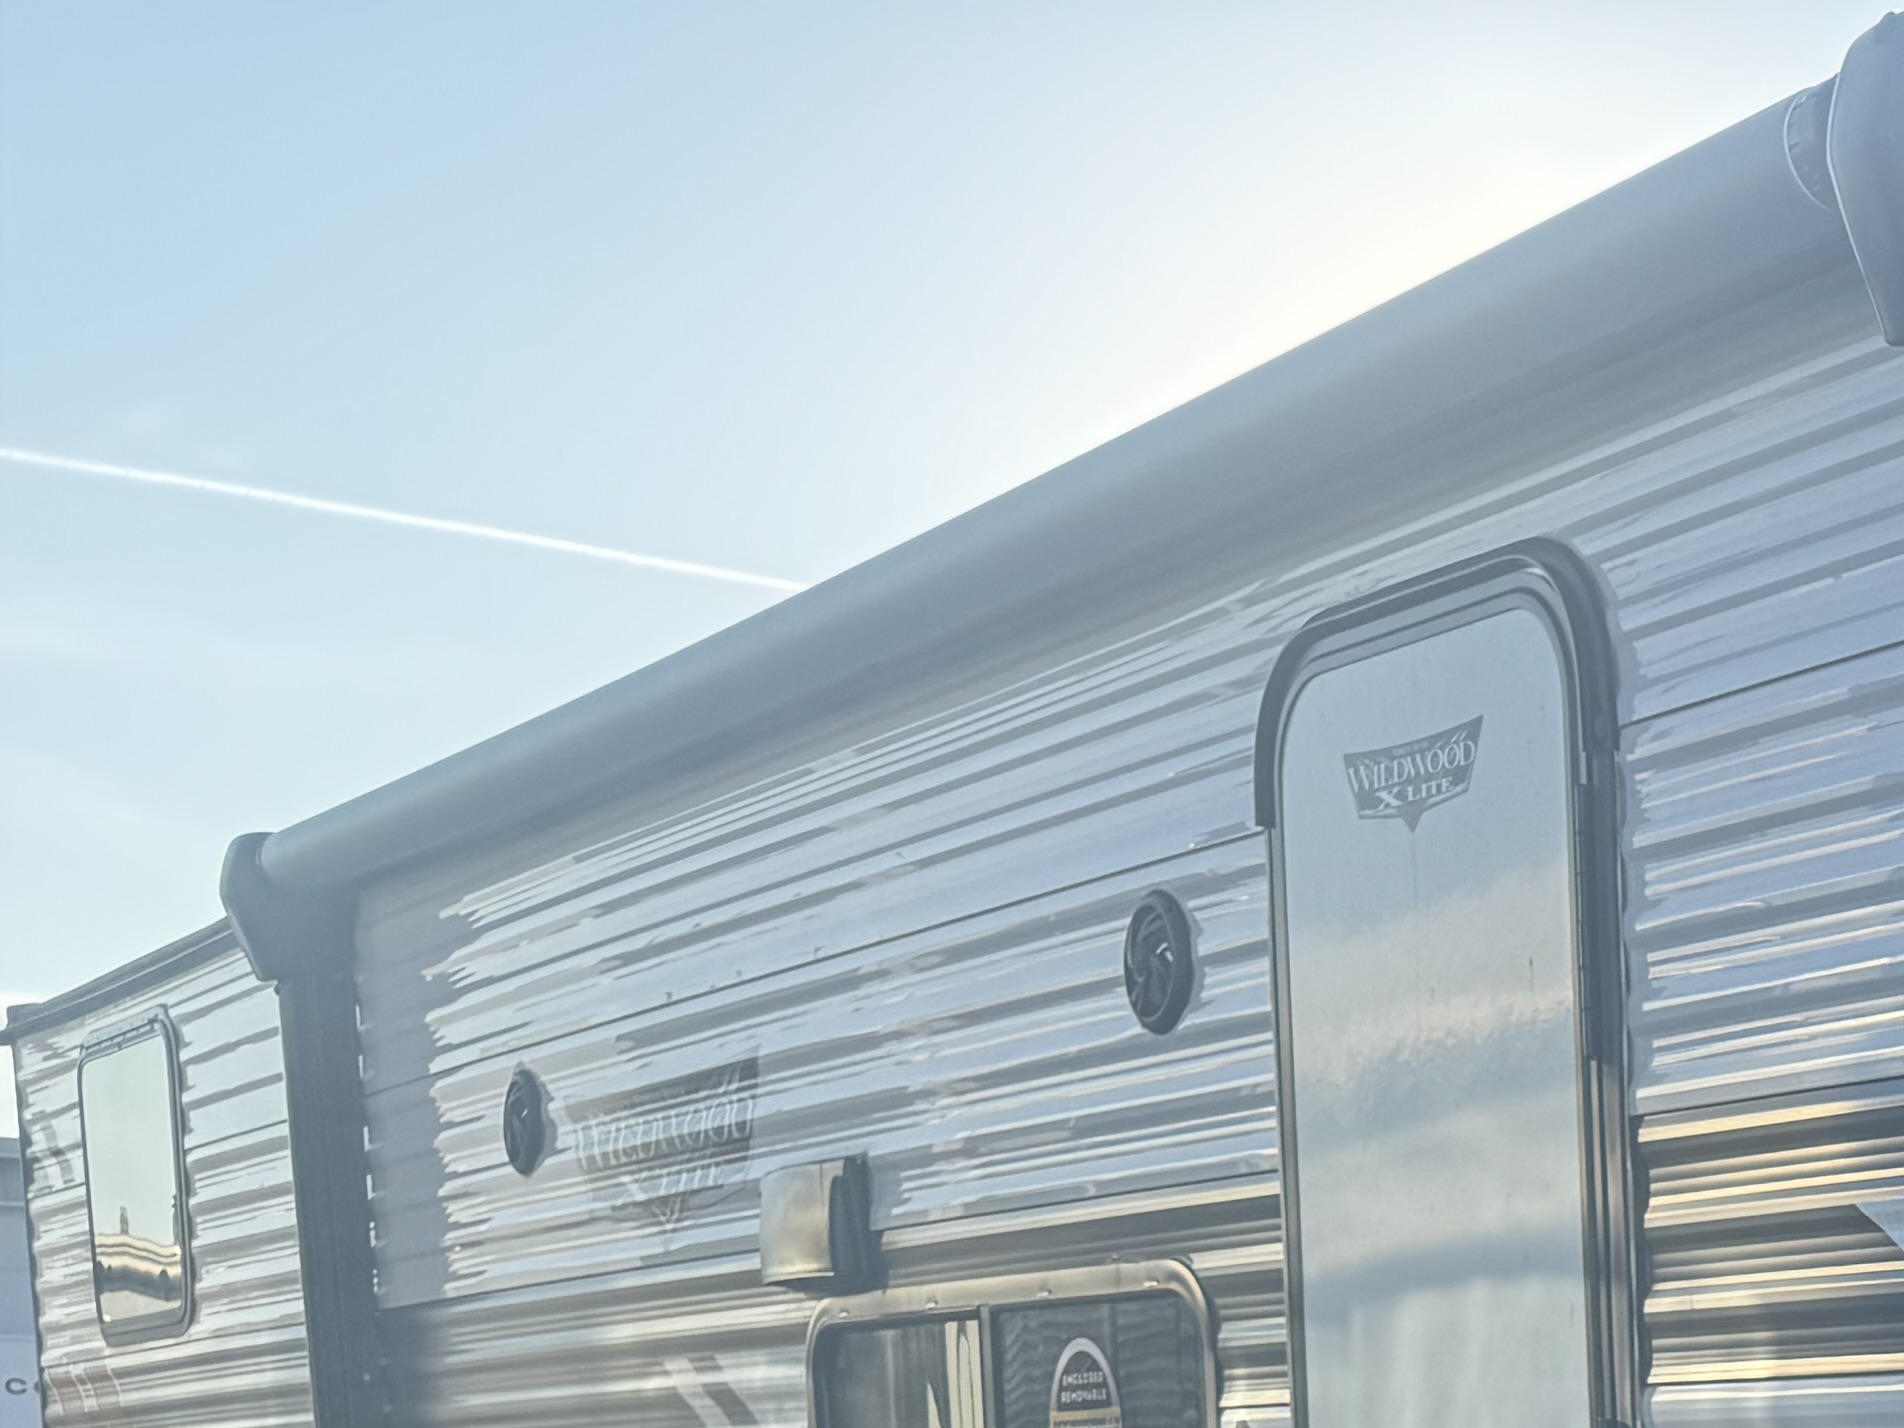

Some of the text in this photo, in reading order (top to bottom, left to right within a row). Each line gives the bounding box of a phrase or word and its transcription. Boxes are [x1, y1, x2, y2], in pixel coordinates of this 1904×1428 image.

[1348, 740, 1475, 793] WILDWOOD
[1374, 777, 1453, 811] X LITE
[1062, 1372, 1104, 1386] ENCLOSED
[1061, 1389, 1107, 1403] REMOVABLE
